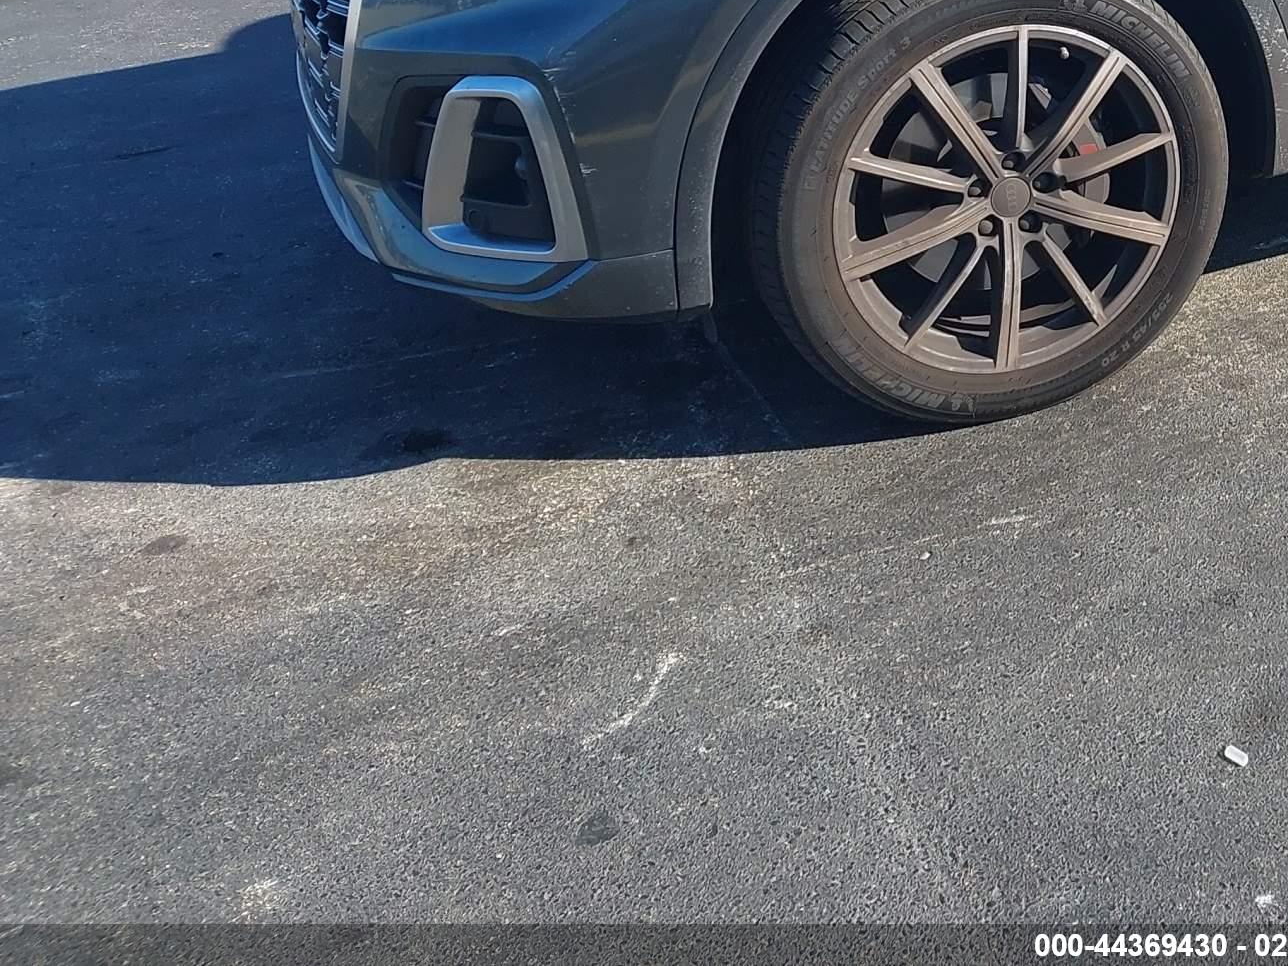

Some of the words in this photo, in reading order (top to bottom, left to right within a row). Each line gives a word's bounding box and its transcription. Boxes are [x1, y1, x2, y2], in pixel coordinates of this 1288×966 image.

[1091, 0, 1193, 79] MICHELIN
[813, 90, 860, 172] LATITUDE
[857, 47, 898, 91] Sport
[900, 36, 914, 50] 3
[826, 334, 946, 409] MICHELIN
